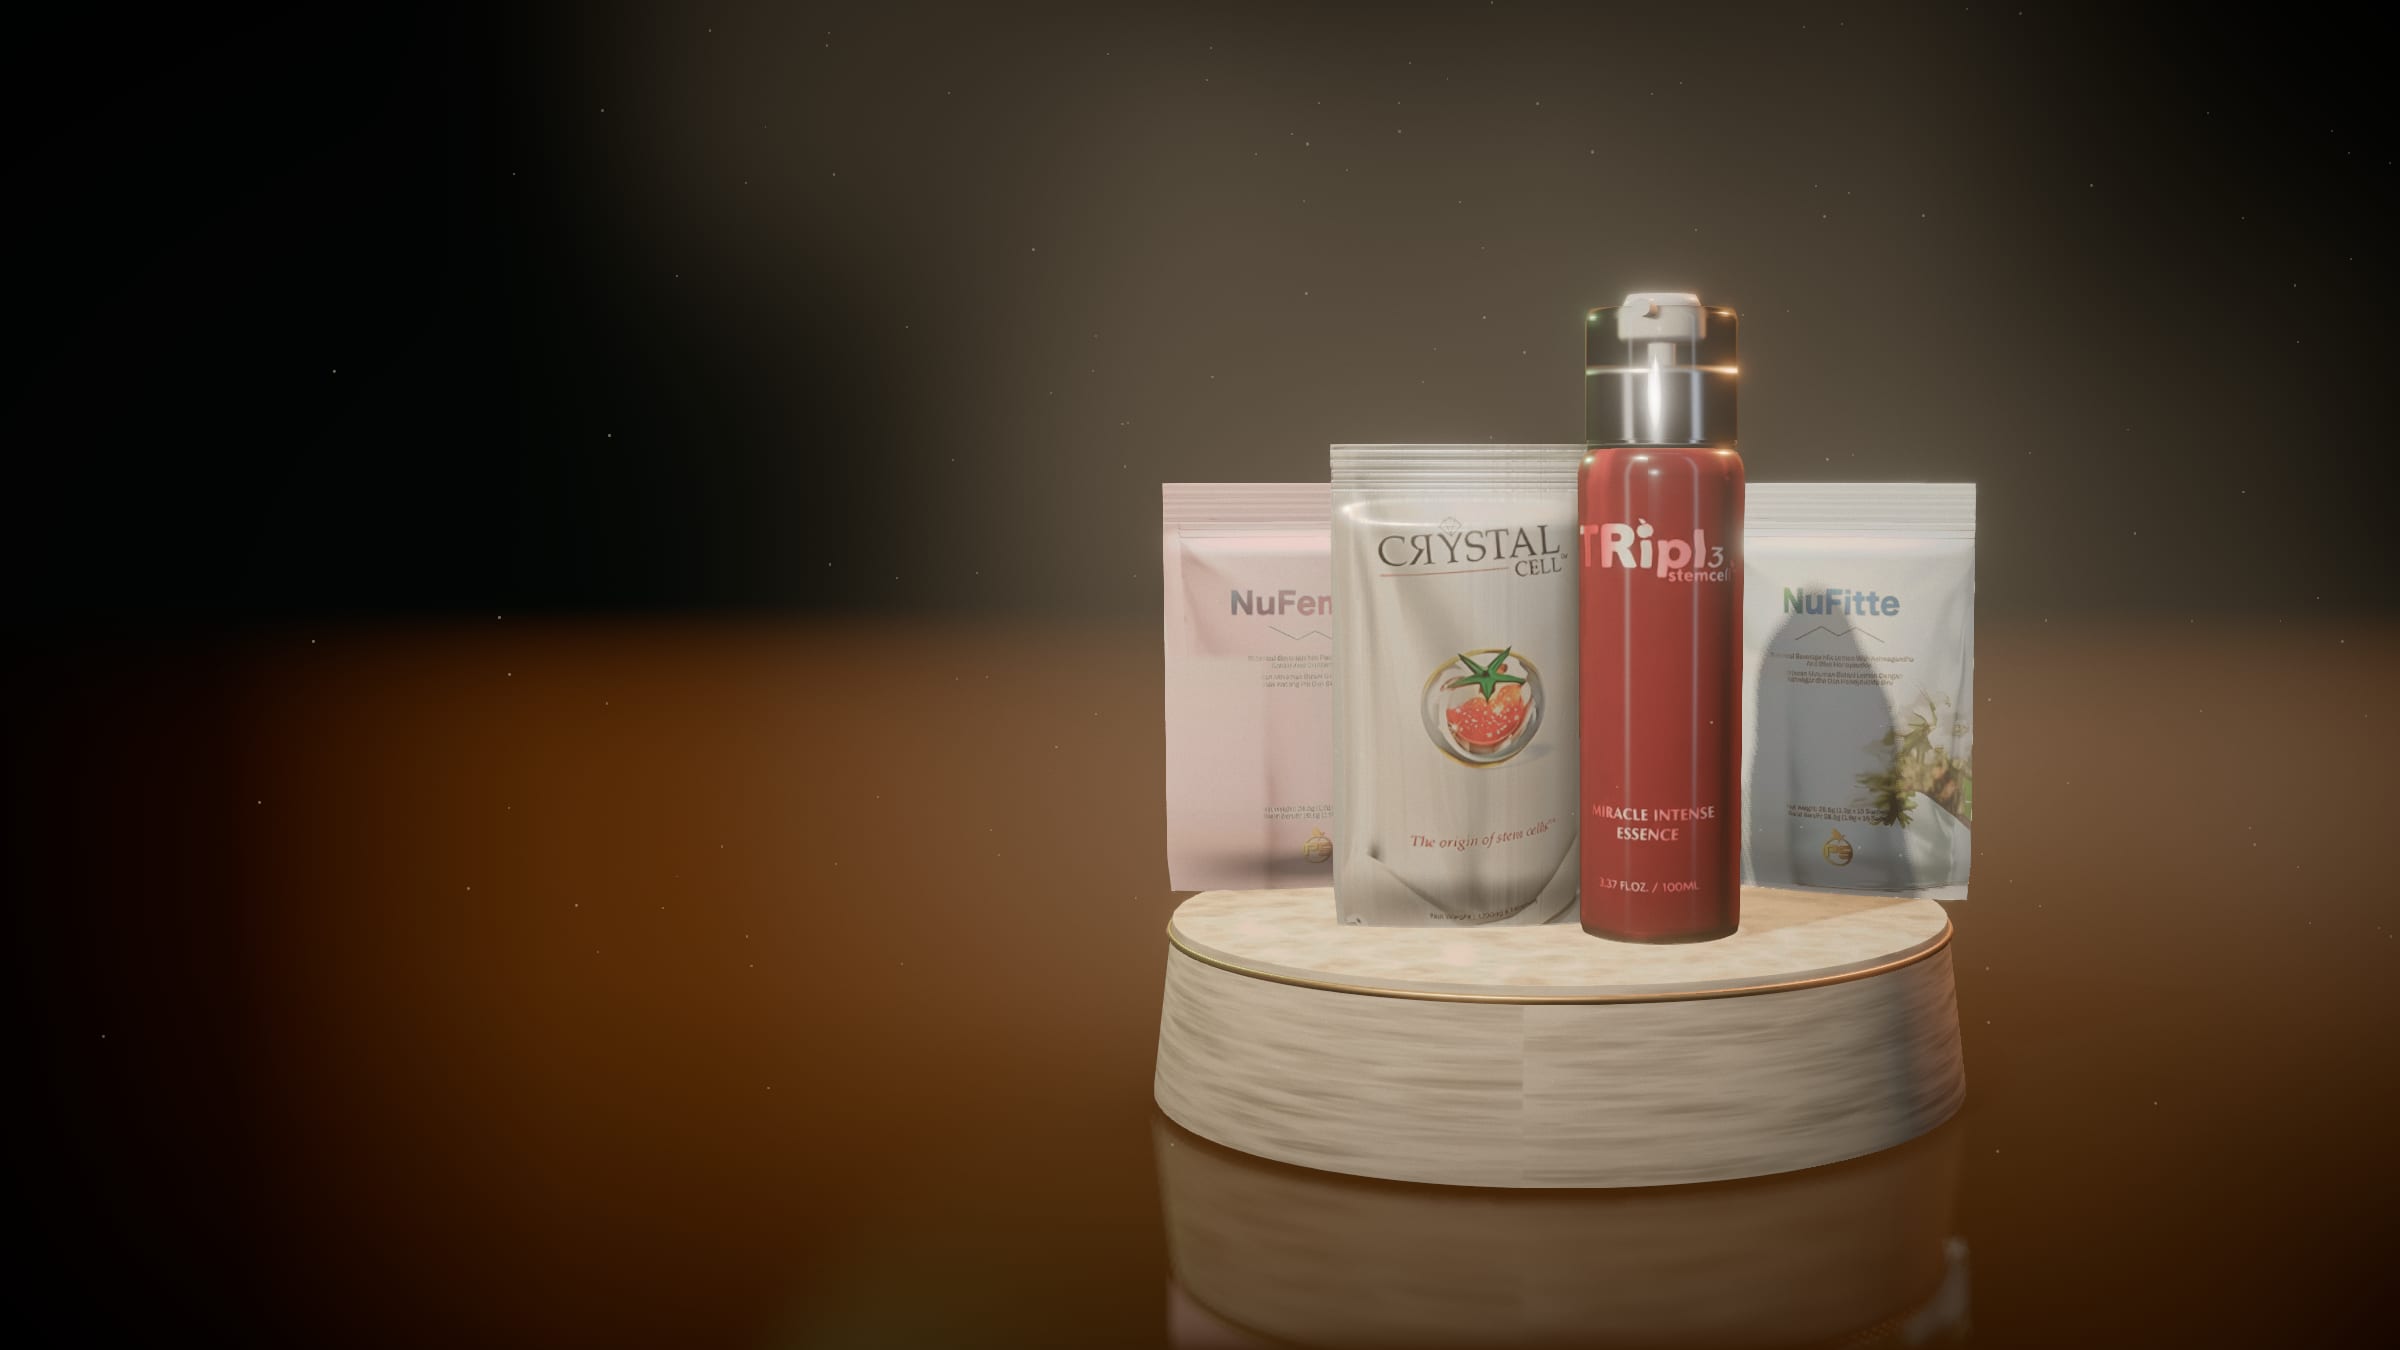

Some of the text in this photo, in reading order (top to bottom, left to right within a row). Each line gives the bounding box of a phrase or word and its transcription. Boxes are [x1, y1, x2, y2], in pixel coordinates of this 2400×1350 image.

[1783, 587, 1900, 616] NuFitte
[1592, 804, 1715, 821] MIRACLE INTENSE
[1410, 834, 1435, 848] The
[1439, 835, 1478, 852] origin
[1481, 831, 1496, 849] of
[1496, 830, 1524, 844] stem
[1616, 827, 1679, 840] ESSENCE
[1663, 881, 1699, 892] 100ML
